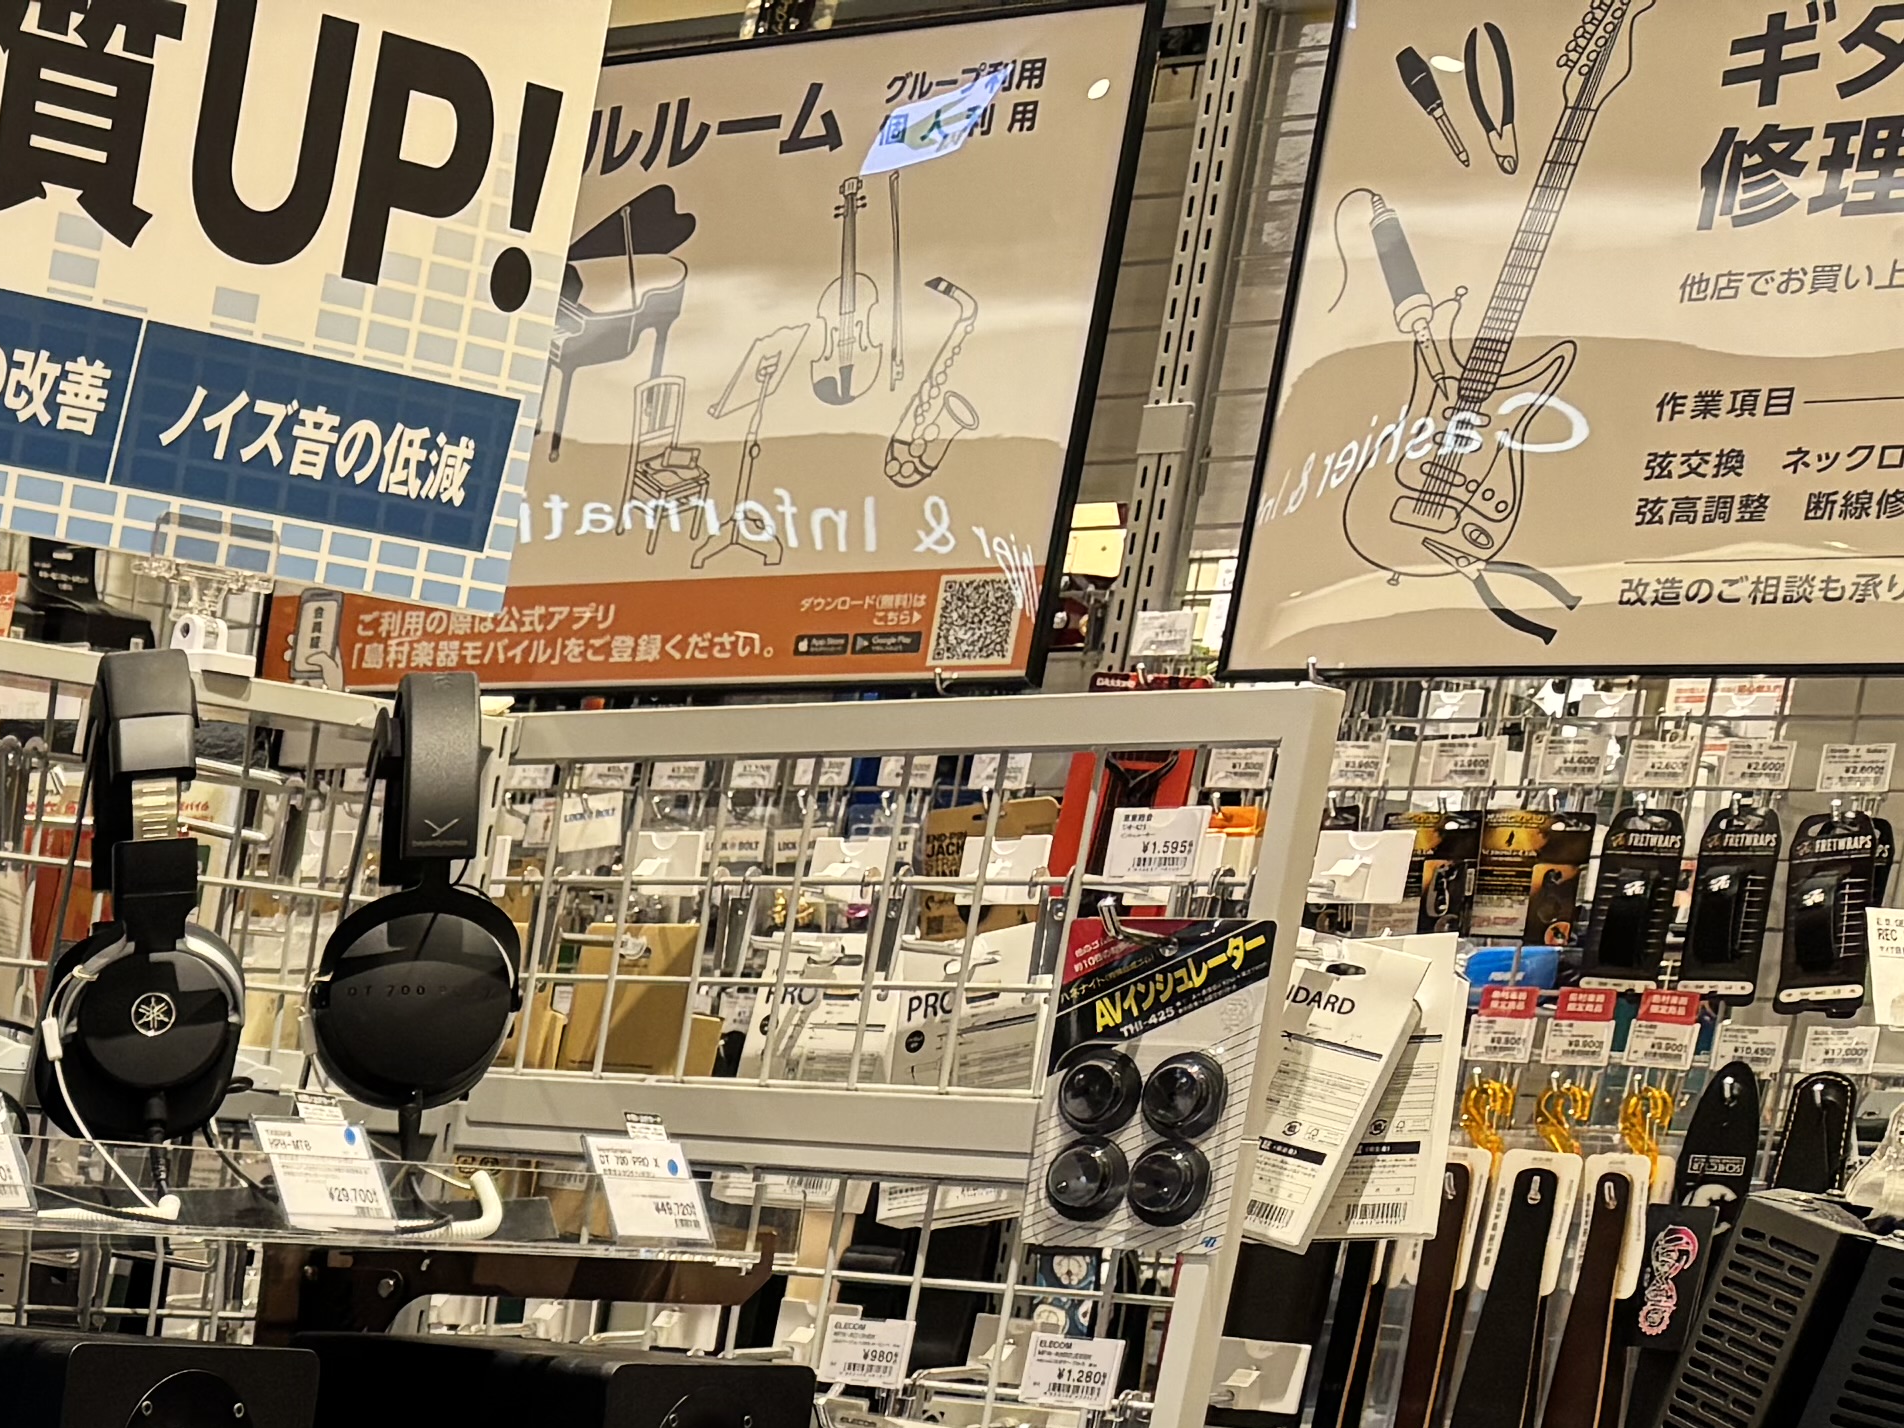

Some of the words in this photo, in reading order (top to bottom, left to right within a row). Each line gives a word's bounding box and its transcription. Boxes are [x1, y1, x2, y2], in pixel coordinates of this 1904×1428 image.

[885, 60, 1047, 98] グループ利用
[1655, 388, 1795, 420] 作業項目
[160, 383, 477, 508] ノイズ音の低減
[1644, 450, 1746, 480] 弦交換
[356, 601, 615, 636] ご利用の際は公式アプリ
[874, 610, 910, 626] こちら
[1142, 840, 1186, 856] ¥1,595
[1628, 834, 1681, 849] FRETWRAPS
[1723, 834, 1777, 847] FRETWRAPS
[1815, 835, 1871, 850] FRETWRAPS
[1094, 934, 1266, 1034] AVインシュレーター
[1120, 1005, 1175, 1039] THI-425
[326, 1186, 374, 1203] ¥29,700
[835, 1322, 865, 1331] ELECOM
[863, 1348, 893, 1363] ¥980
[1058, 1369, 1103, 1384] ¥1,280
